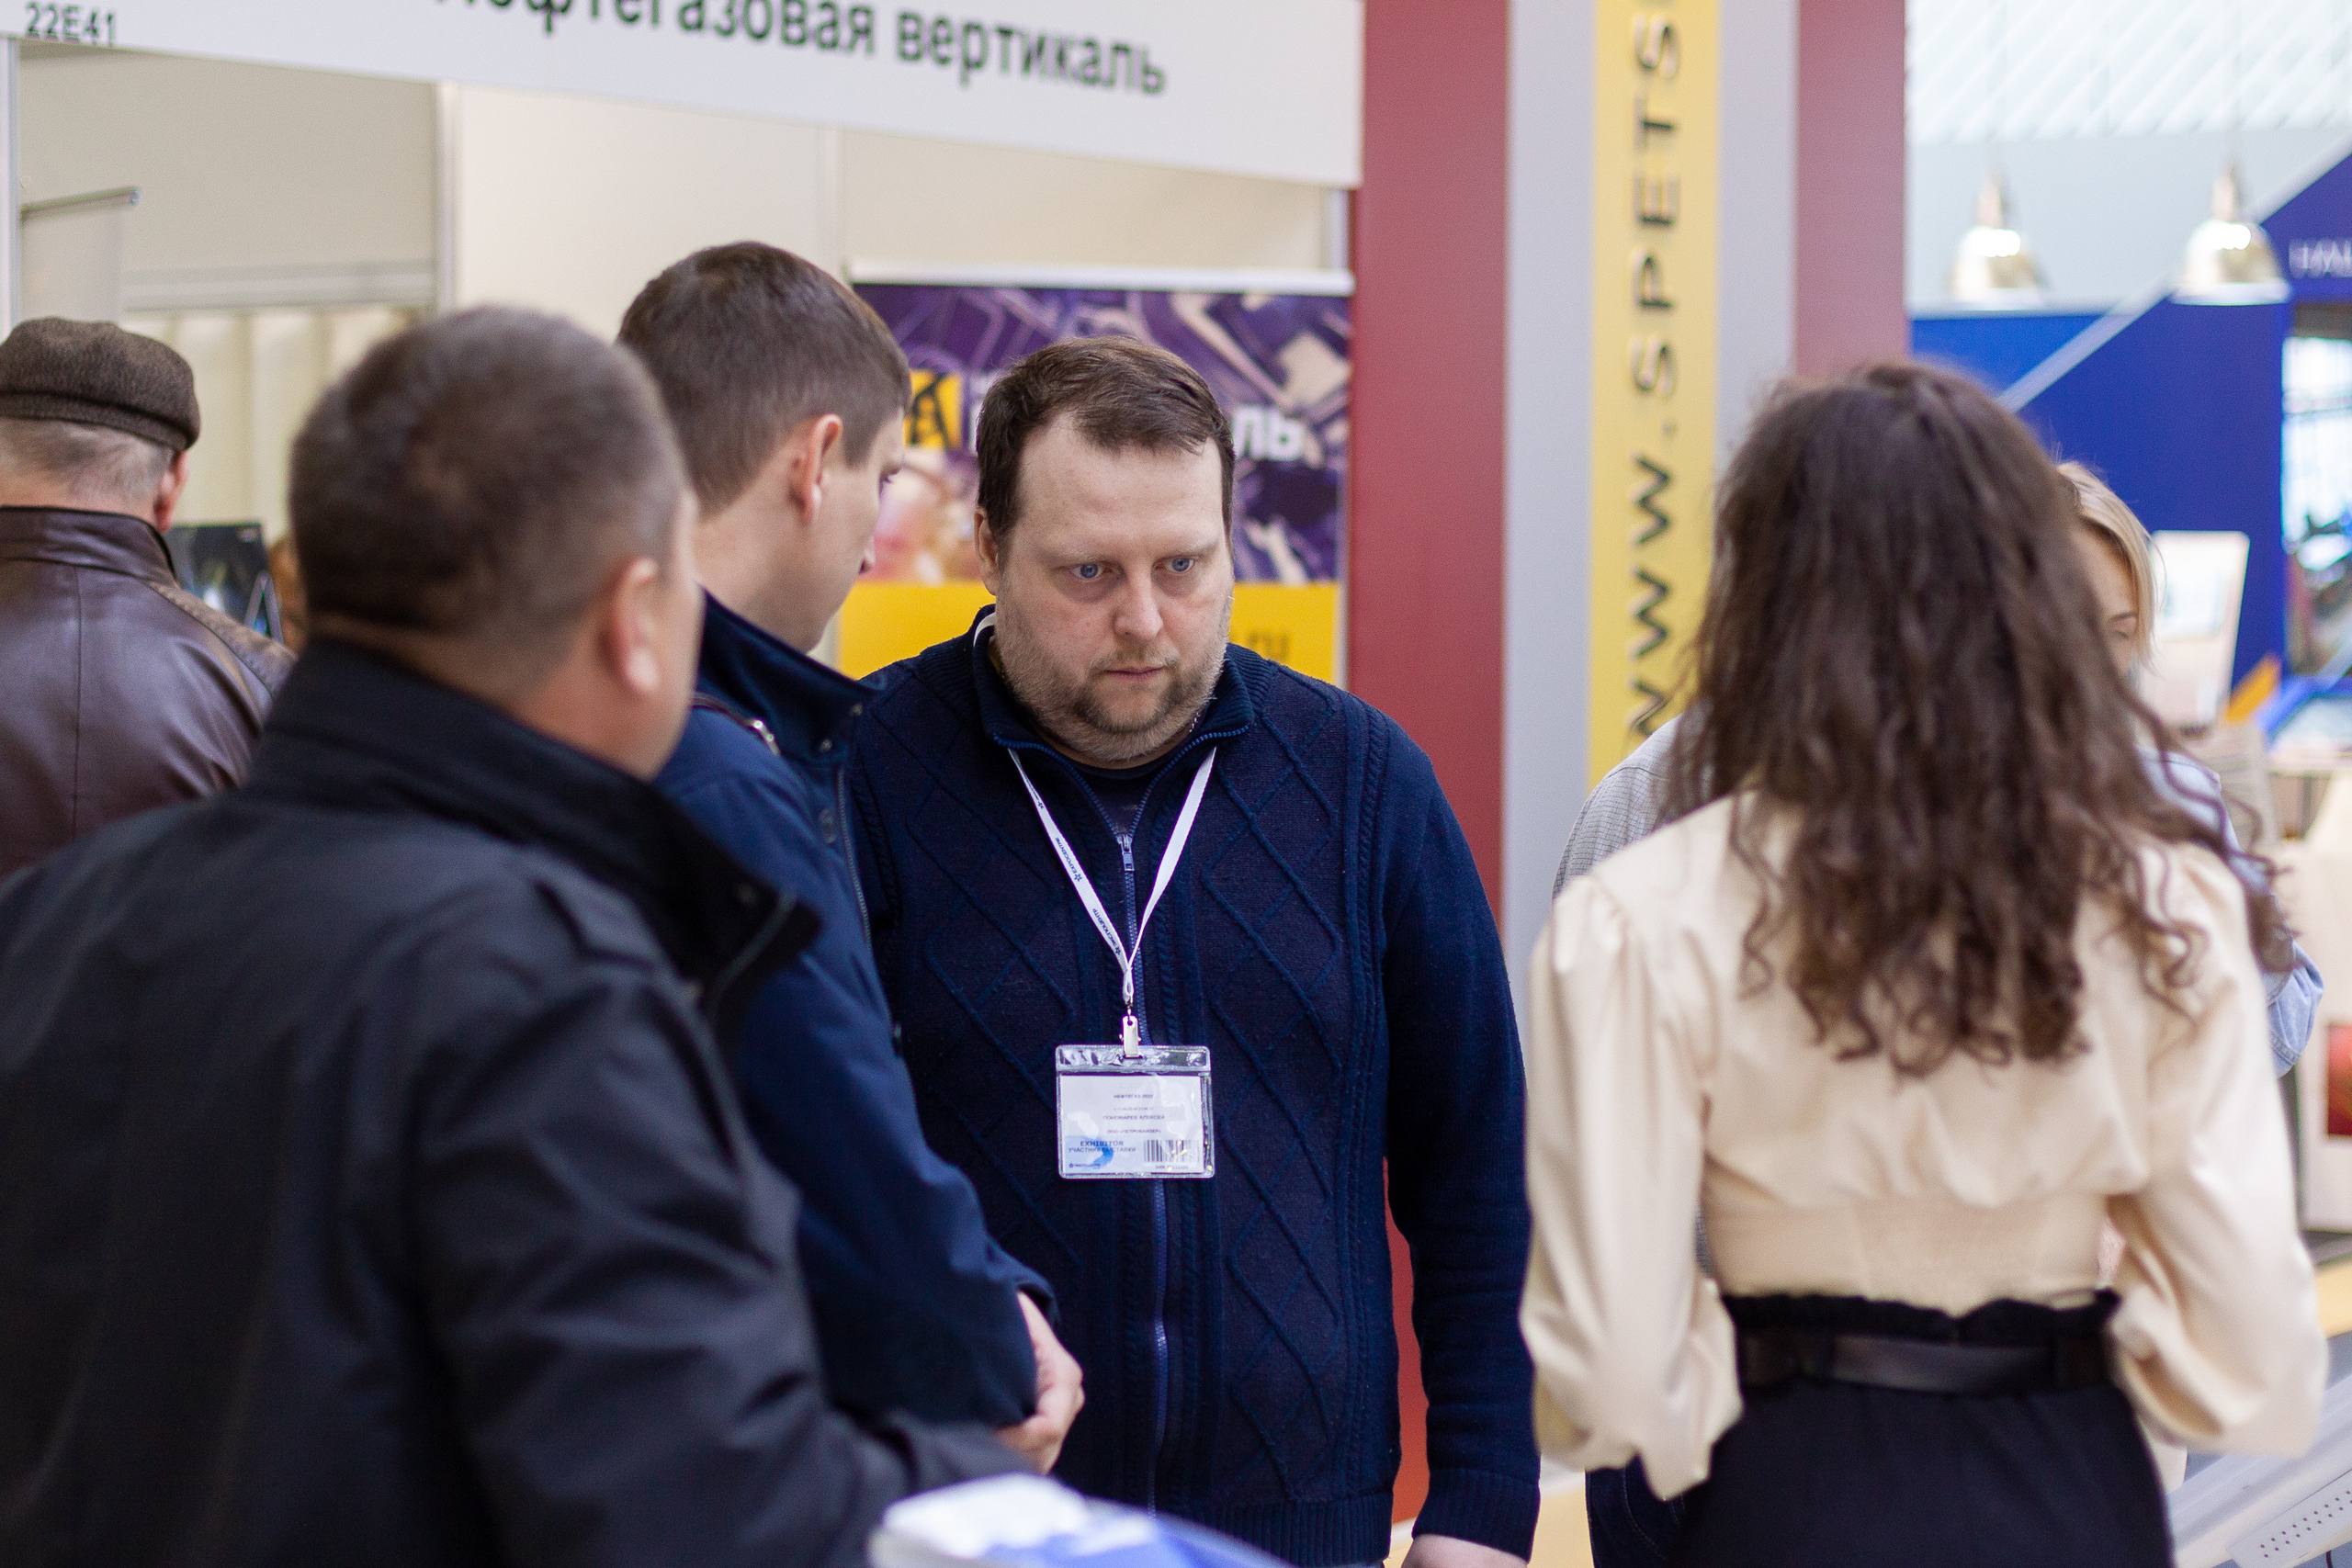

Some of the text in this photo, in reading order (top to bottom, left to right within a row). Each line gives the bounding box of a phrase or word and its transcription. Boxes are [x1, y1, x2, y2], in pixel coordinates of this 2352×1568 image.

[27, 2, 116, 46] 22E41
[897, 12, 1168, 94] вертикаль
[1055, 836, 1078, 875] EXPOCENTRE
